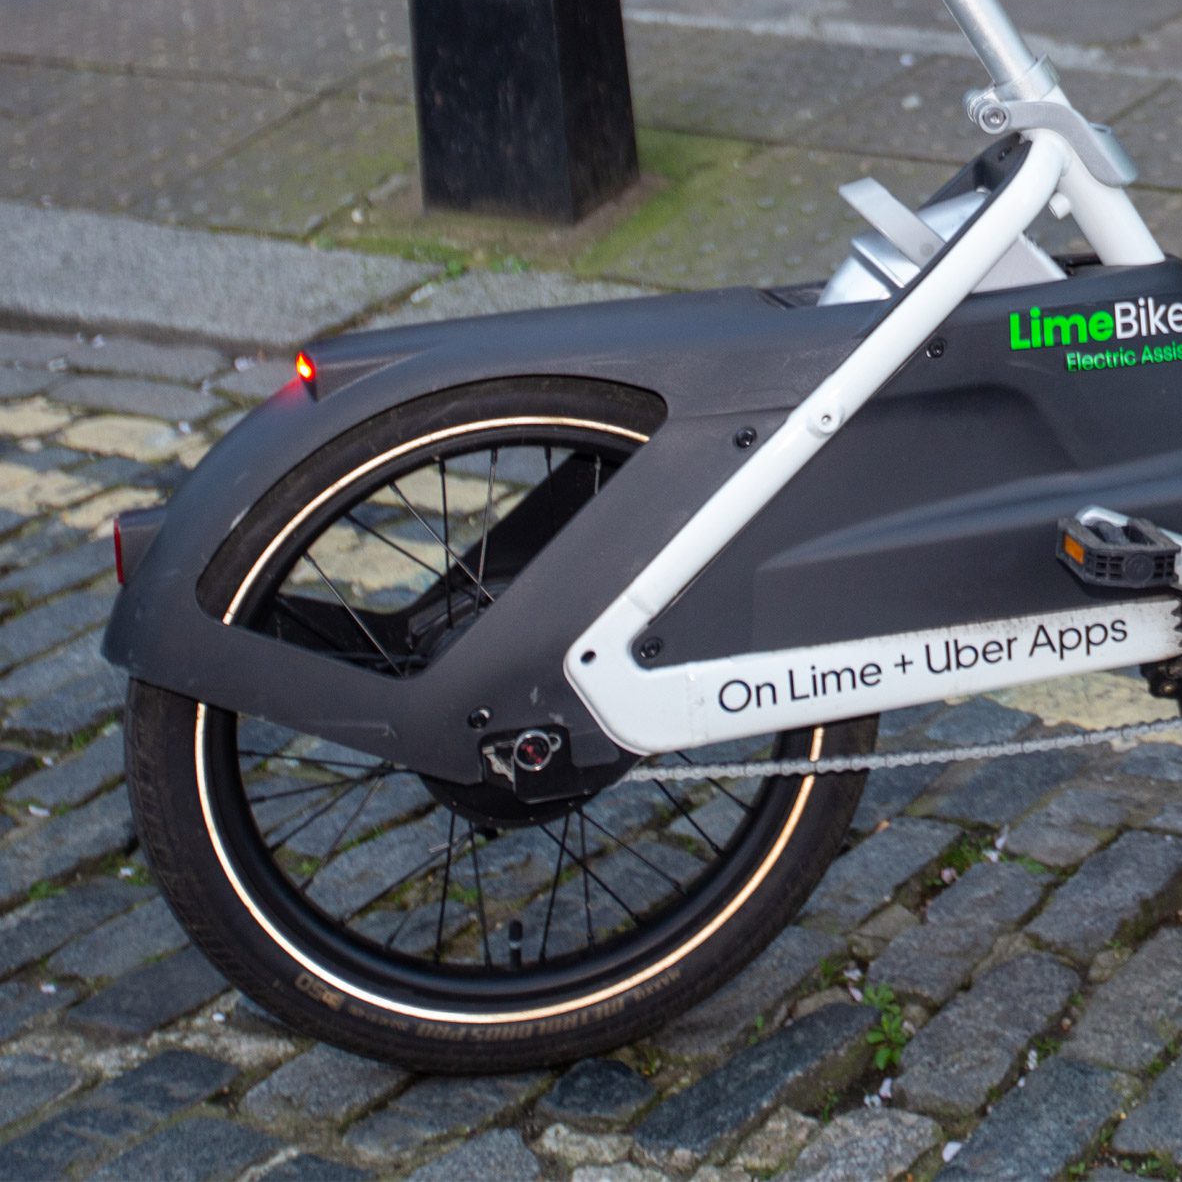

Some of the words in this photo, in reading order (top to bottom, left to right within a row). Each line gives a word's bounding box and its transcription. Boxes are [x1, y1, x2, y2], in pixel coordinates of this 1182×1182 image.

[1066, 346, 1137, 372] Electric
[718, 679, 777, 714] On
[788, 660, 882, 702] Lime
[894, 653, 914, 676] +
[925, 636, 1018, 675] Uber
[1029, 618, 1128, 660] Apps
